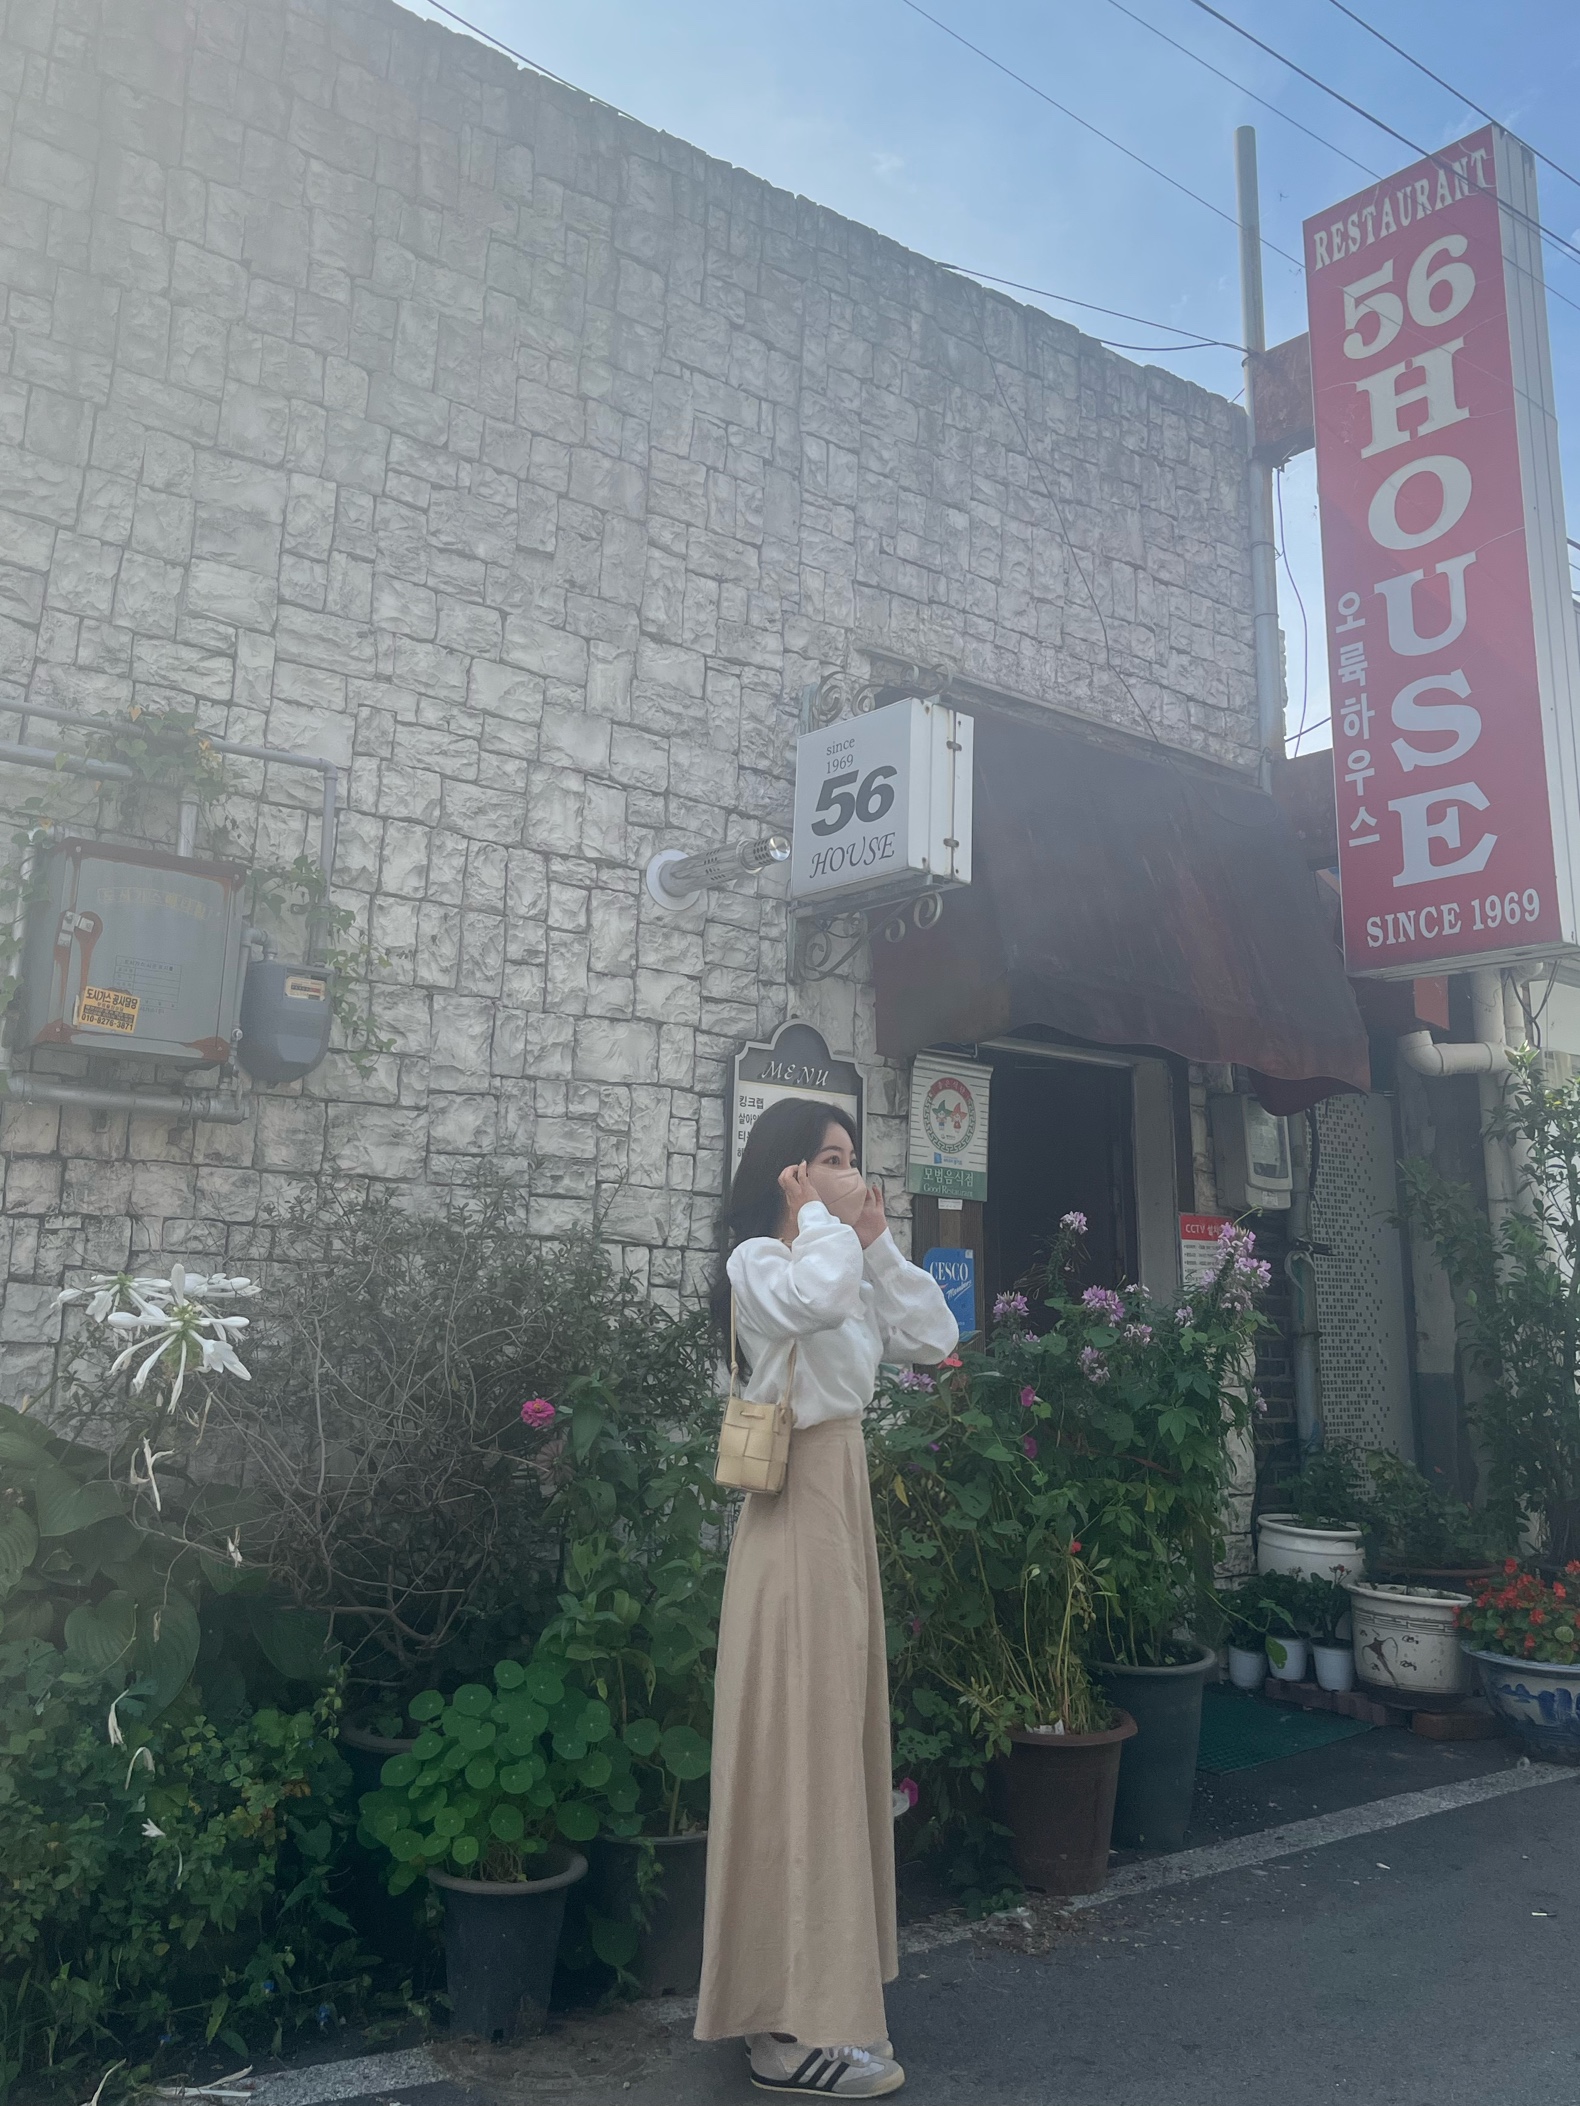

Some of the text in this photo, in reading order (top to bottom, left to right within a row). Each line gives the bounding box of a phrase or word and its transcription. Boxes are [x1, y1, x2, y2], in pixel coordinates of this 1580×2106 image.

[1312, 147, 1488, 272] RESTAURANT
[1342, 234, 1476, 360] 56
[1356, 336, 1498, 888] HOUSE
[1335, 591, 1380, 848] 오륙하우스
[826, 737, 856, 756] since
[826, 754, 854, 774] 1969
[811, 765, 898, 837] 56
[809, 832, 896, 879] HOUSE
[1366, 888, 1541, 949] SINCE 1969
[86, 988, 111, 1003] 도시가스
[760, 1060, 829, 1087] MENU
[739, 1095, 764, 1110] 킹크랩
[923, 1167, 974, 1187] 모범음식점
[923, 1183, 973, 1198] Good Restaurant
[1185, 1224, 1206, 1234] CCTV
[929, 1261, 969, 1282] CESCO
